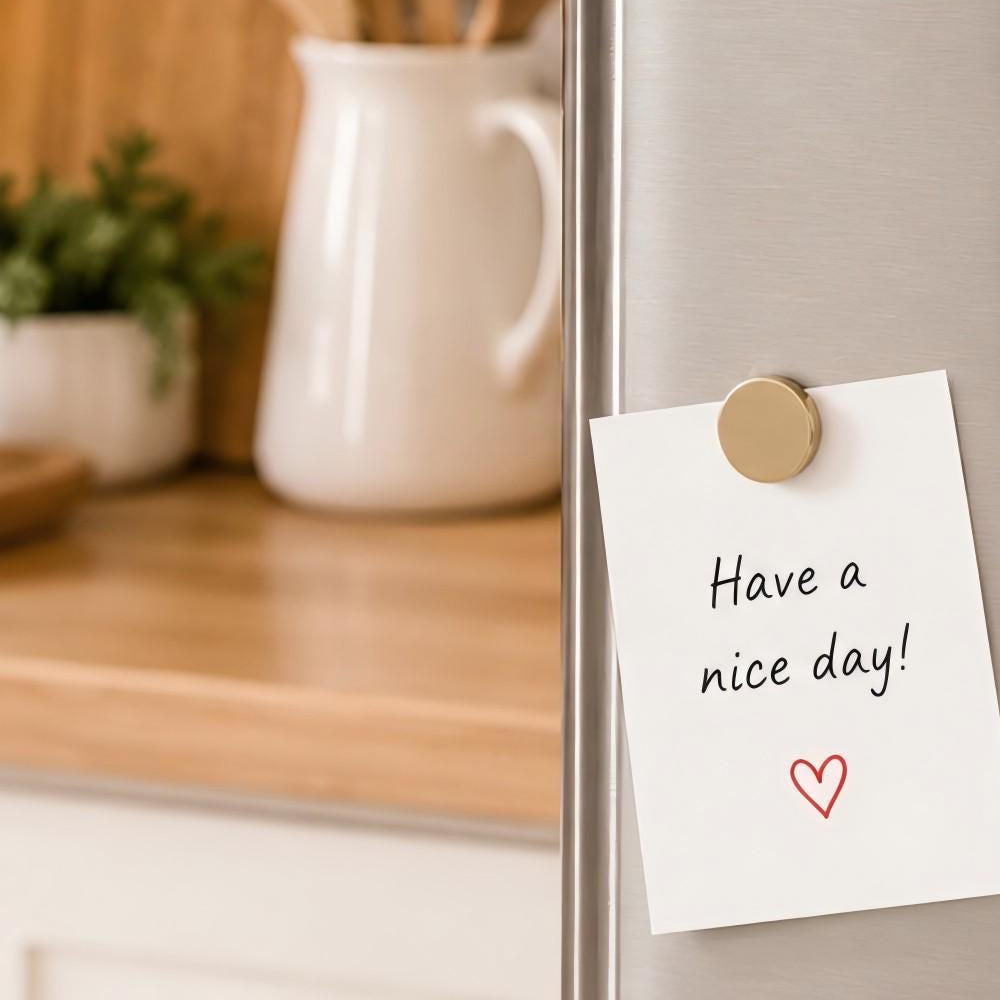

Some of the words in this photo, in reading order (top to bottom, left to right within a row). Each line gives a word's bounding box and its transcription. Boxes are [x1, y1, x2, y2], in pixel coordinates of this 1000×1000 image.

[710, 554, 818, 609] Have
[839, 561, 867, 589] a
[701, 651, 791, 694] nice
[812, 622, 910, 698] day!
